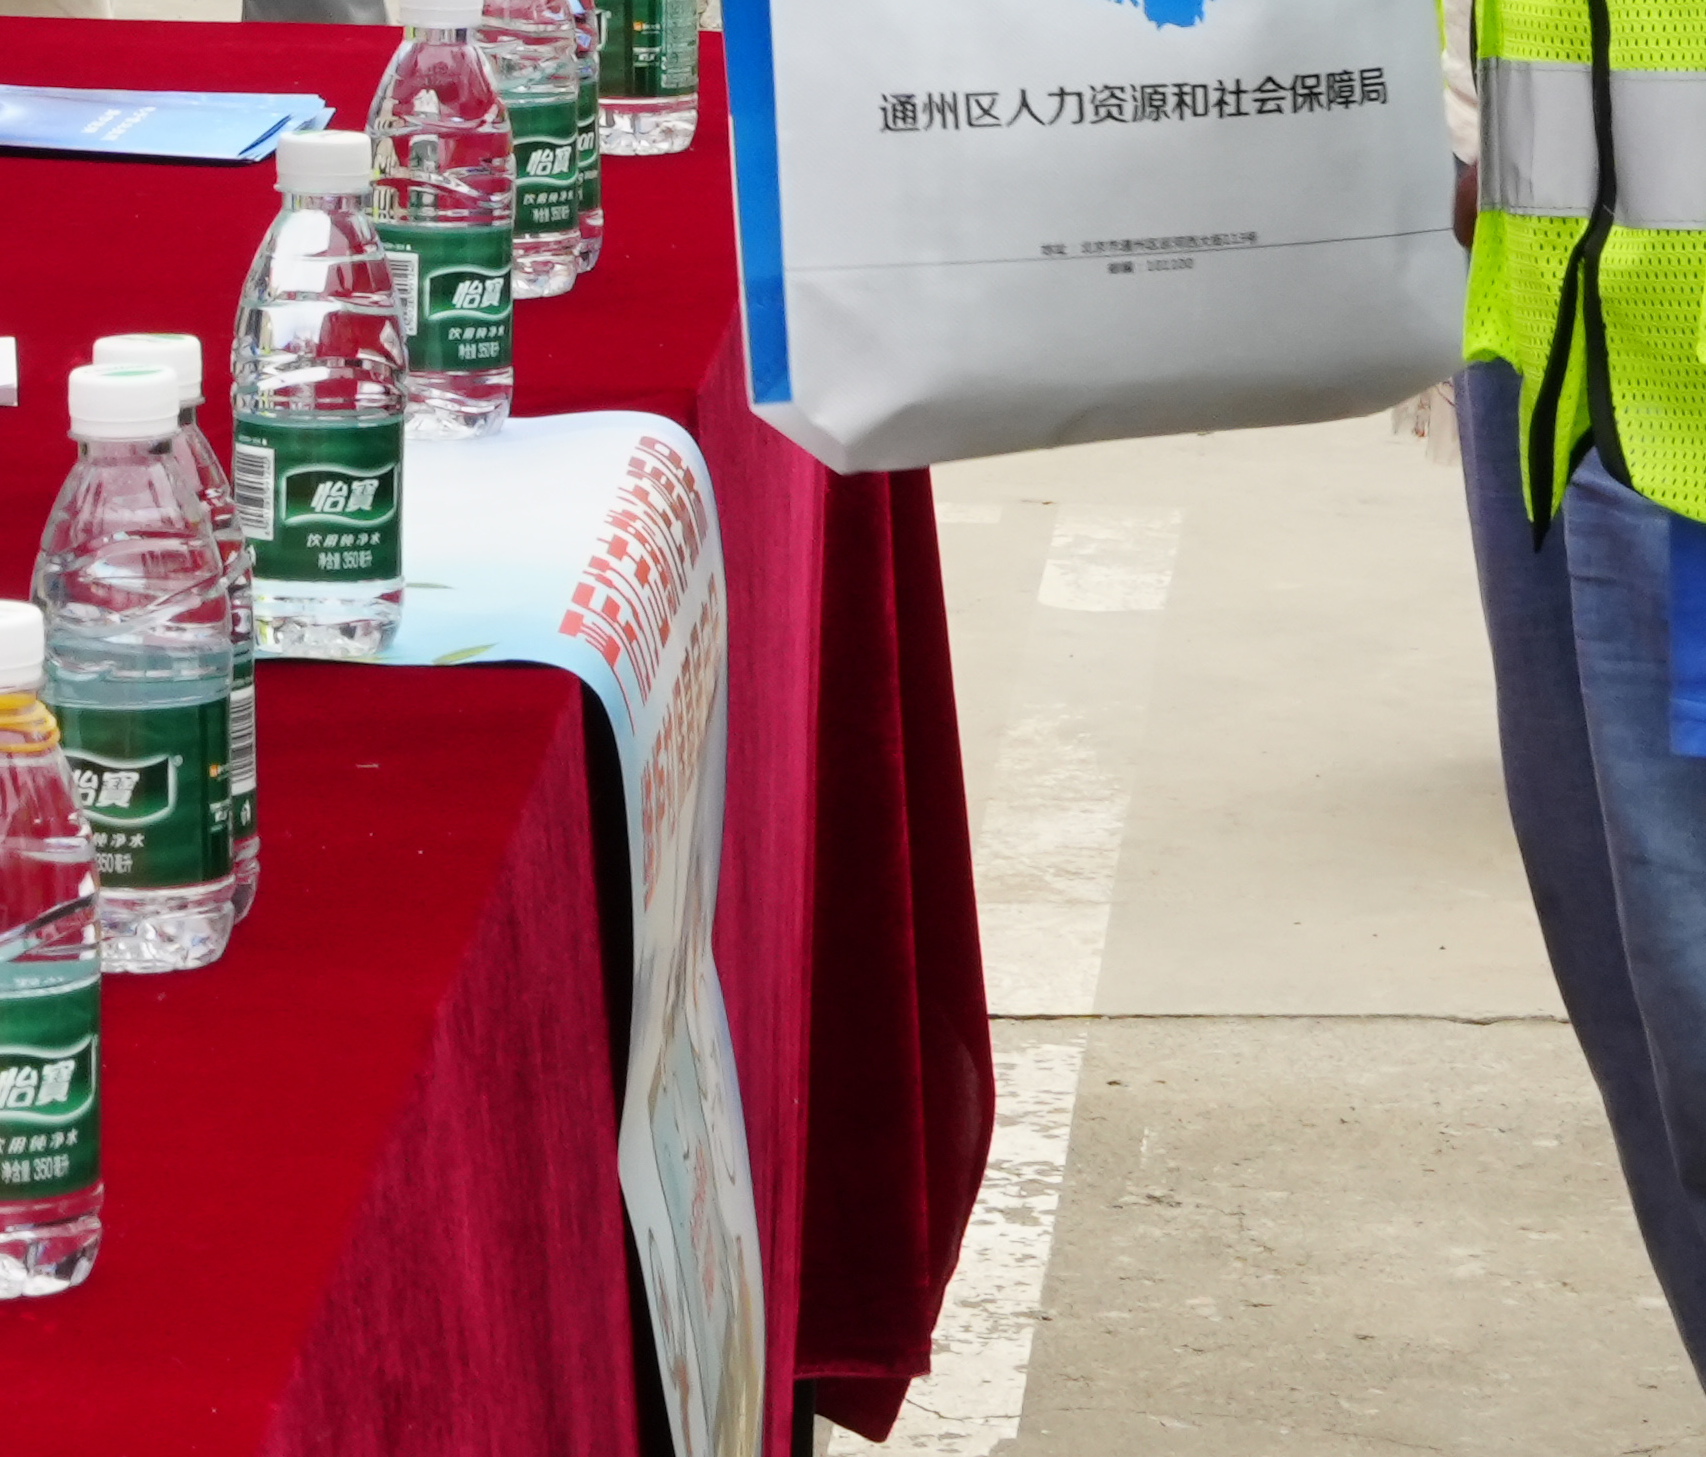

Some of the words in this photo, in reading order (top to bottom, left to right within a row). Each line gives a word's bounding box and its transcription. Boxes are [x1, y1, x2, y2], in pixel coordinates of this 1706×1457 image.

[878, 68, 1389, 134] 通州区人力资源和社会保障局
[452, 278, 505, 309] 怡寶
[310, 478, 380, 513] 怡寶
